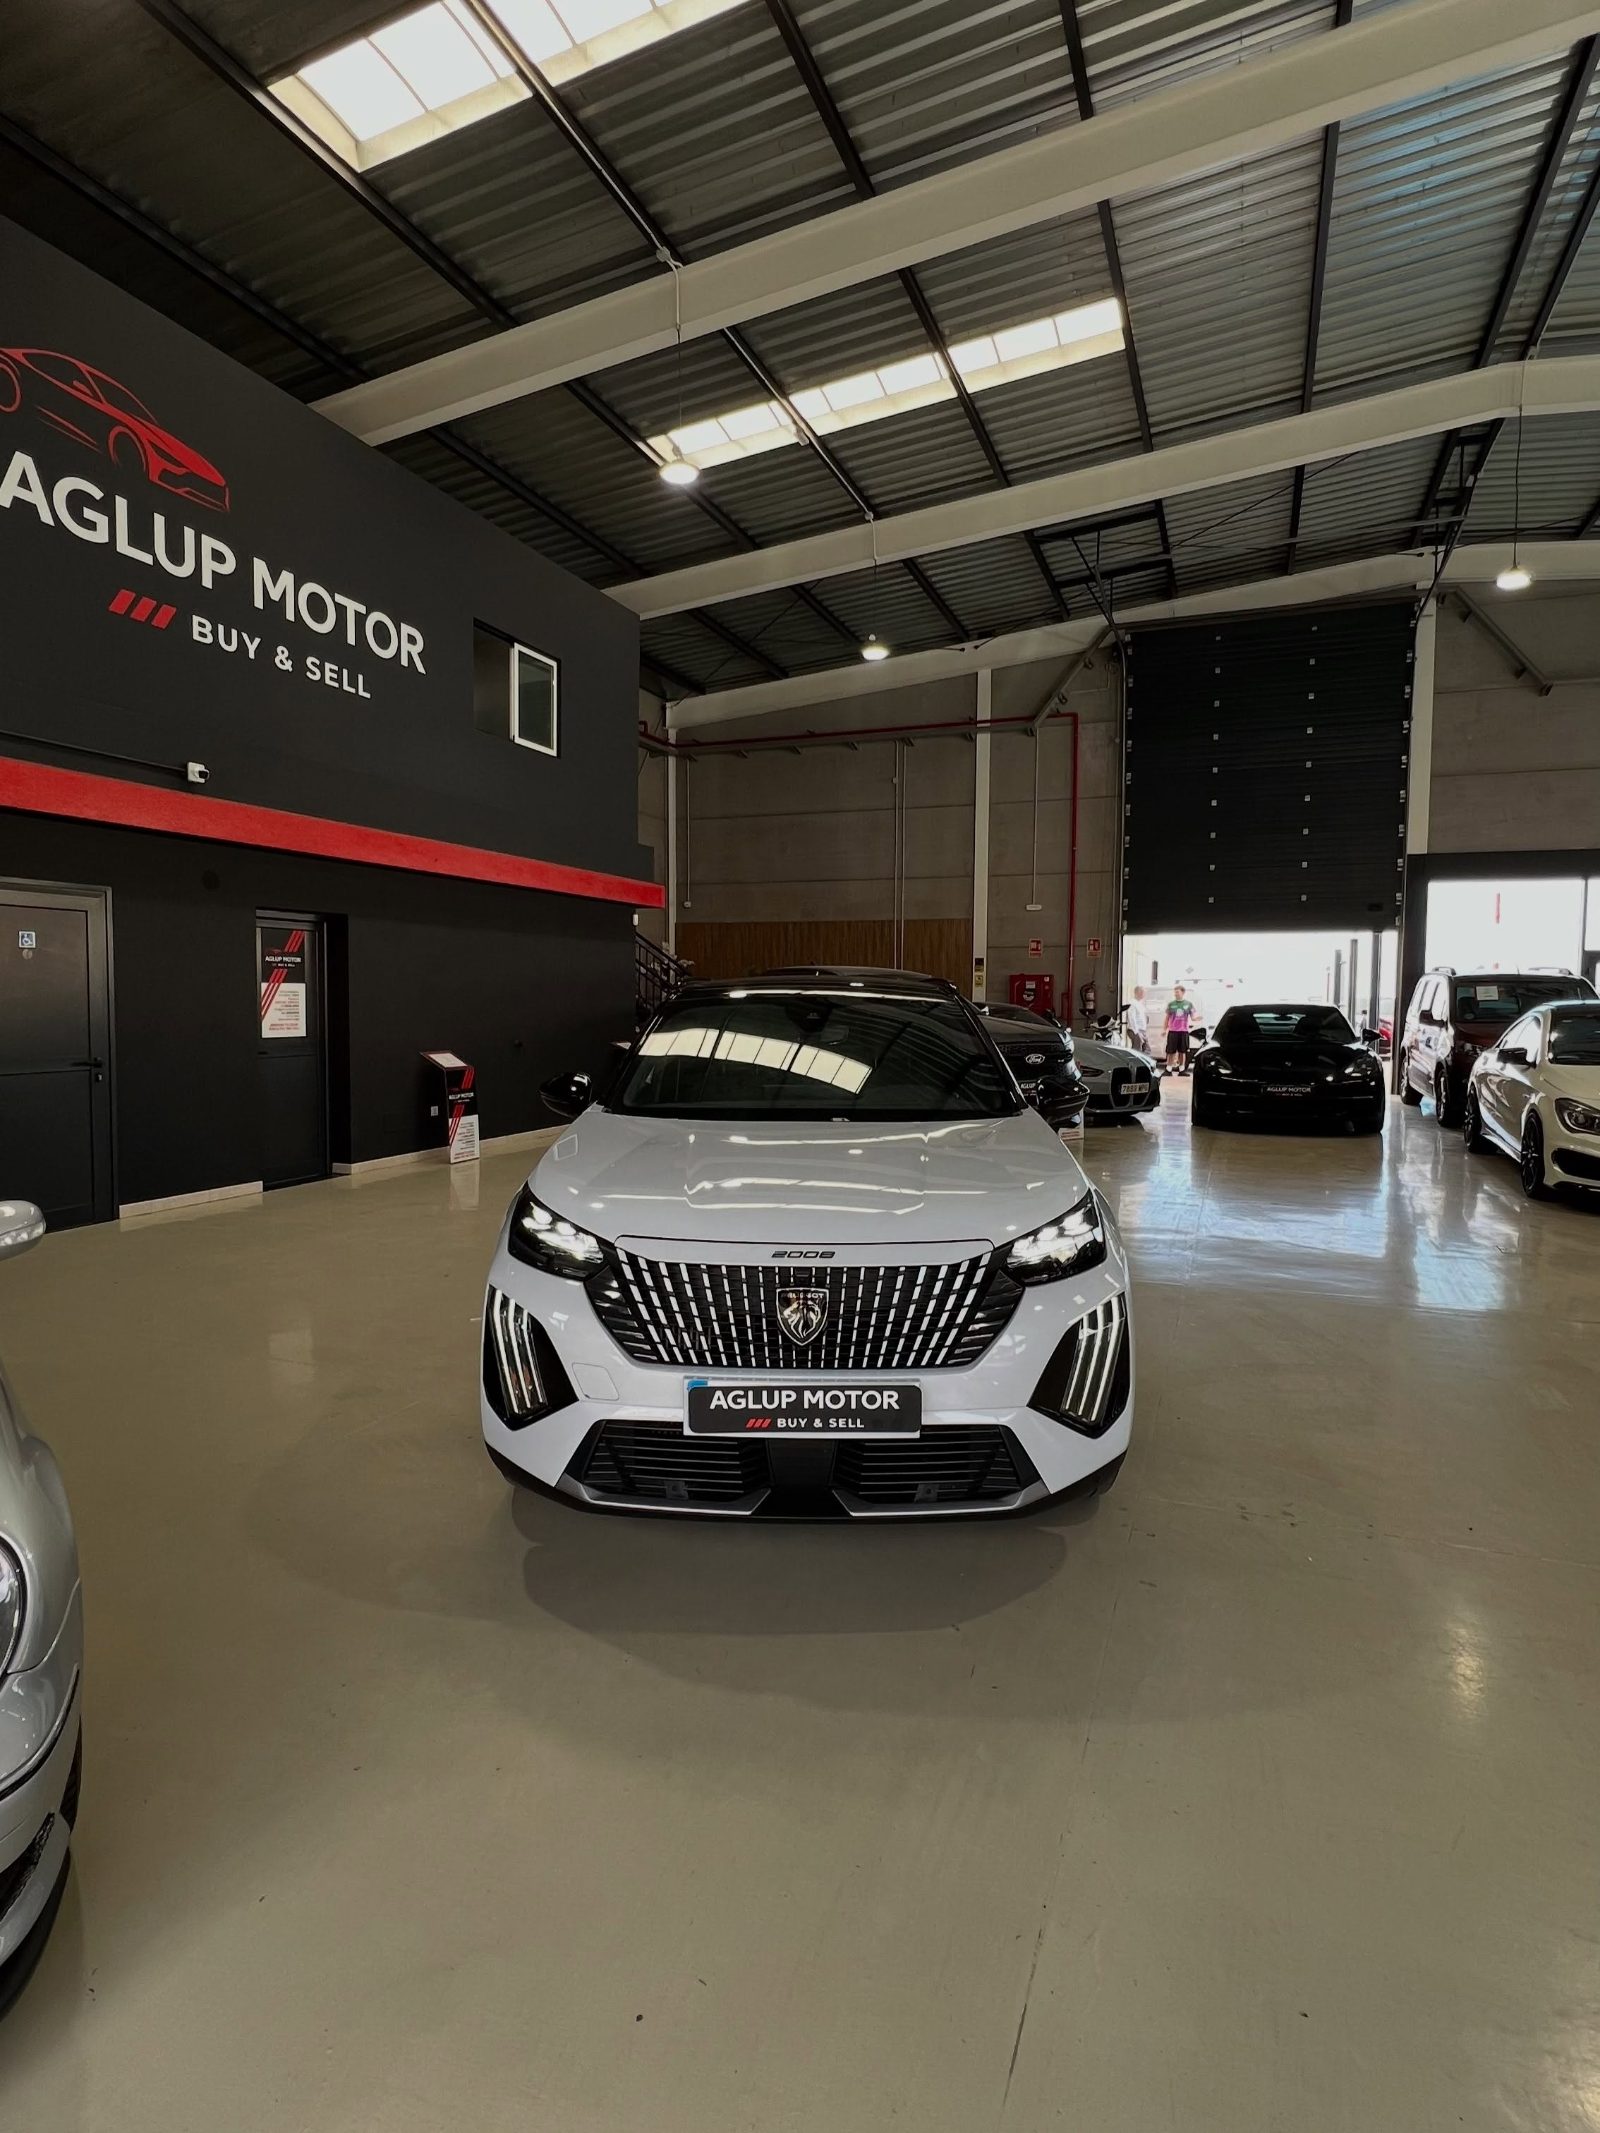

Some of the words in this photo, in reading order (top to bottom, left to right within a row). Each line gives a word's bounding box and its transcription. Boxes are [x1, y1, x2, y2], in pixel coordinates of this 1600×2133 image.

[0, 451, 236, 589] AGLUP
[253, 557, 426, 674] MOTOR
[192, 615, 261, 659] BUY
[275, 645, 292, 672] &
[306, 657, 371, 699] SELL
[709, 1390, 797, 1410] AGLUP
[803, 1390, 900, 1410] MOTOR
[777, 1418, 807, 1428] BUY
[813, 1418, 823, 1428] &
[829, 1418, 864, 1428] SELL
